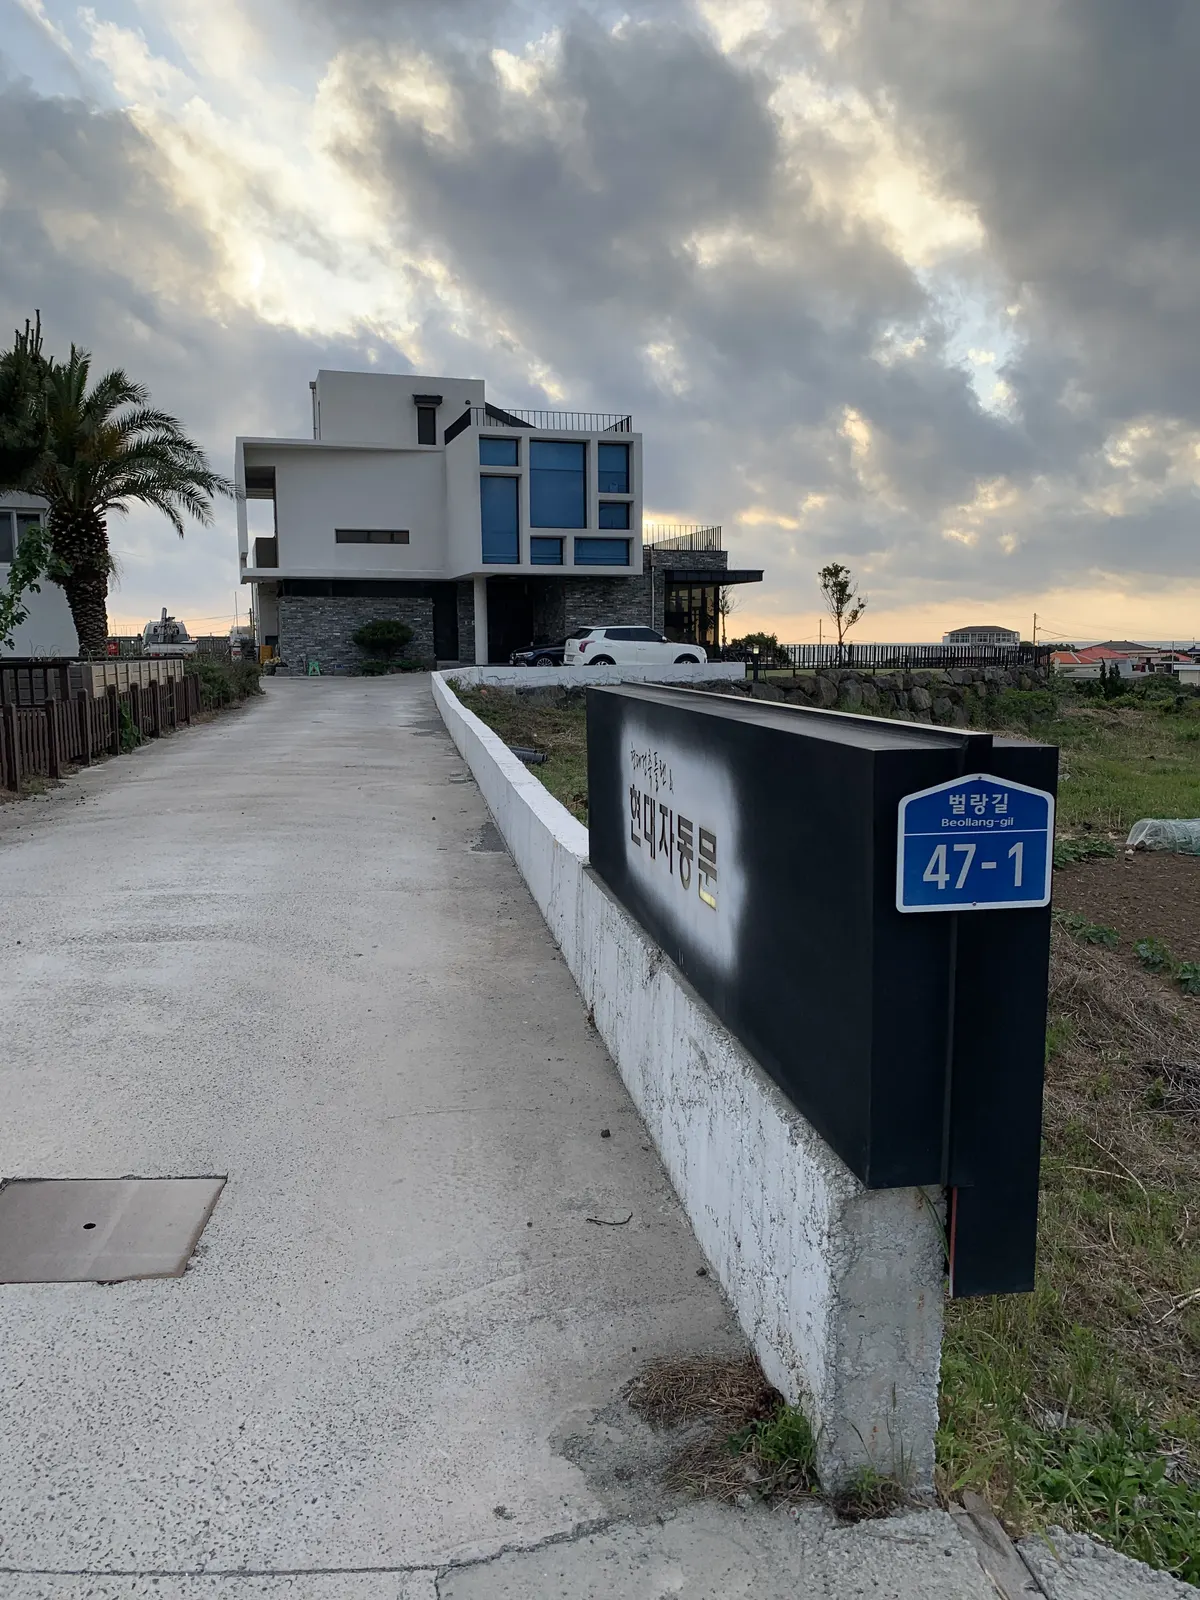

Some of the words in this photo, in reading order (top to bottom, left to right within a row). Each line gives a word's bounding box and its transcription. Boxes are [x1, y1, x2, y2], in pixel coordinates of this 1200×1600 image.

[949, 793, 1008, 815] 벌랑길
[941, 817, 1014, 828] Beollang-gil
[630, 784, 717, 911] 현대자동문
[922, 841, 1024, 890] 47-1
